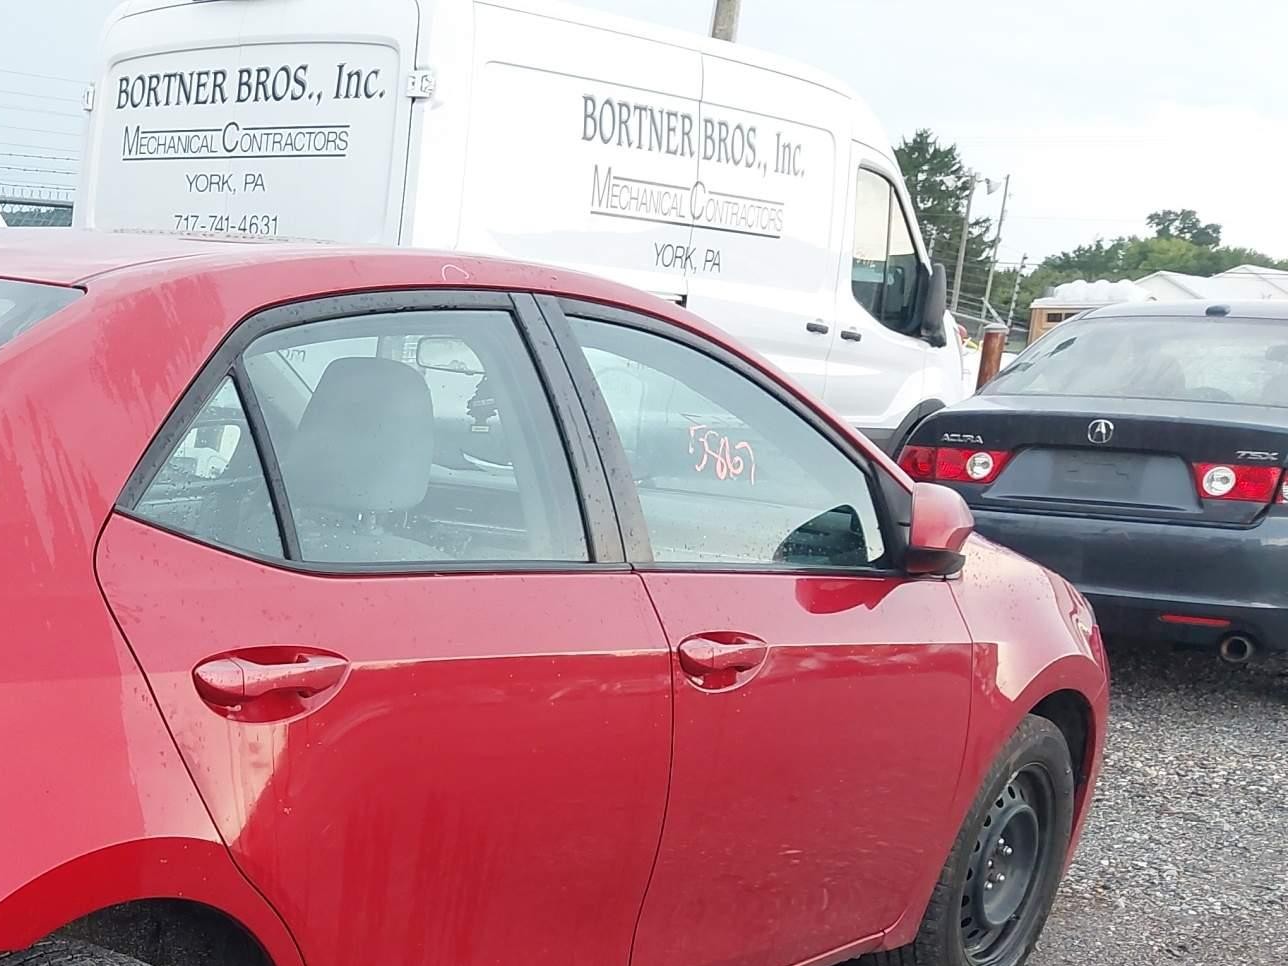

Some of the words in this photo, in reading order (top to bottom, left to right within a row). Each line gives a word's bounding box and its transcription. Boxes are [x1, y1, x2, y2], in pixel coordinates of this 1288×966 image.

[116, 69, 227, 110] BORTNER
[235, 64, 322, 105] BROS.,
[333, 62, 386, 99] Inc.
[581, 95, 695, 158] BORTNER
[702, 117, 767, 177] BROS.,
[774, 132, 805, 177] Inc.
[185, 173, 237, 194] YORK,
[243, 173, 266, 193] PA
[174, 214, 278, 236] 717-741-4631
[654, 242, 697, 273] YORK,
[703, 249, 722, 273] PA
[940, 432, 985, 445] ACURA
[1235, 450, 1280, 461] TSX
